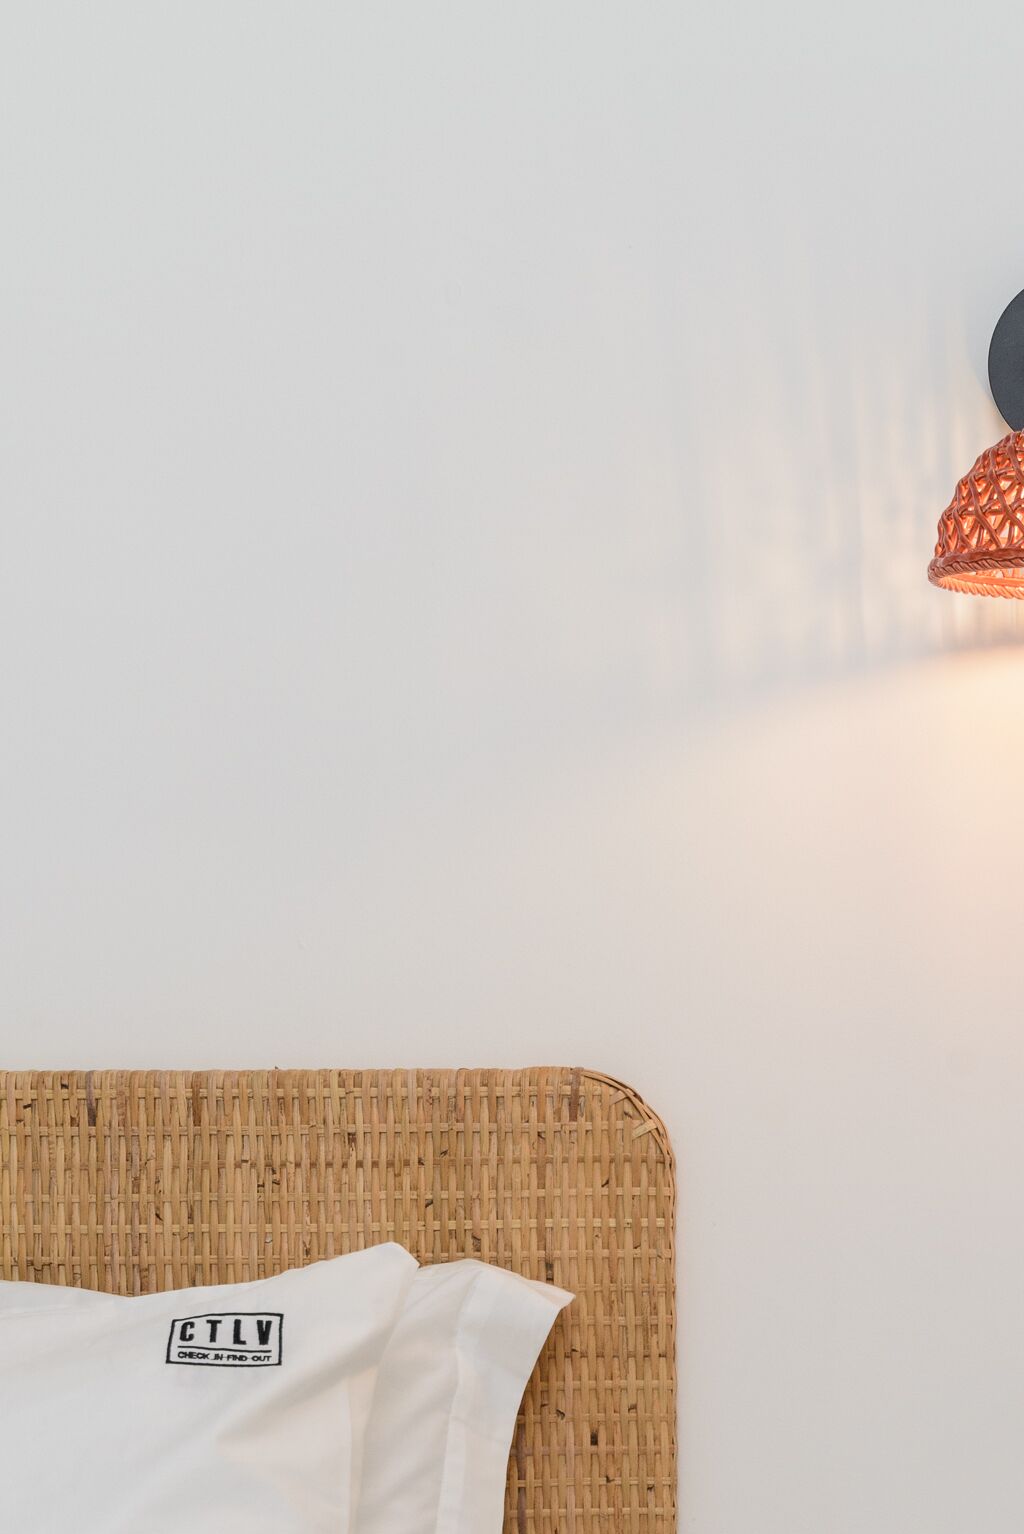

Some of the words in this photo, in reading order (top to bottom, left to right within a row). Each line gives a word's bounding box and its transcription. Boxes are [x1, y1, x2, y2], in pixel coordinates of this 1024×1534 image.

[179, 1318, 272, 1346] CTLV
[177, 1351, 210, 1360] CHECK
[211, 1353, 223, 1361] IN
